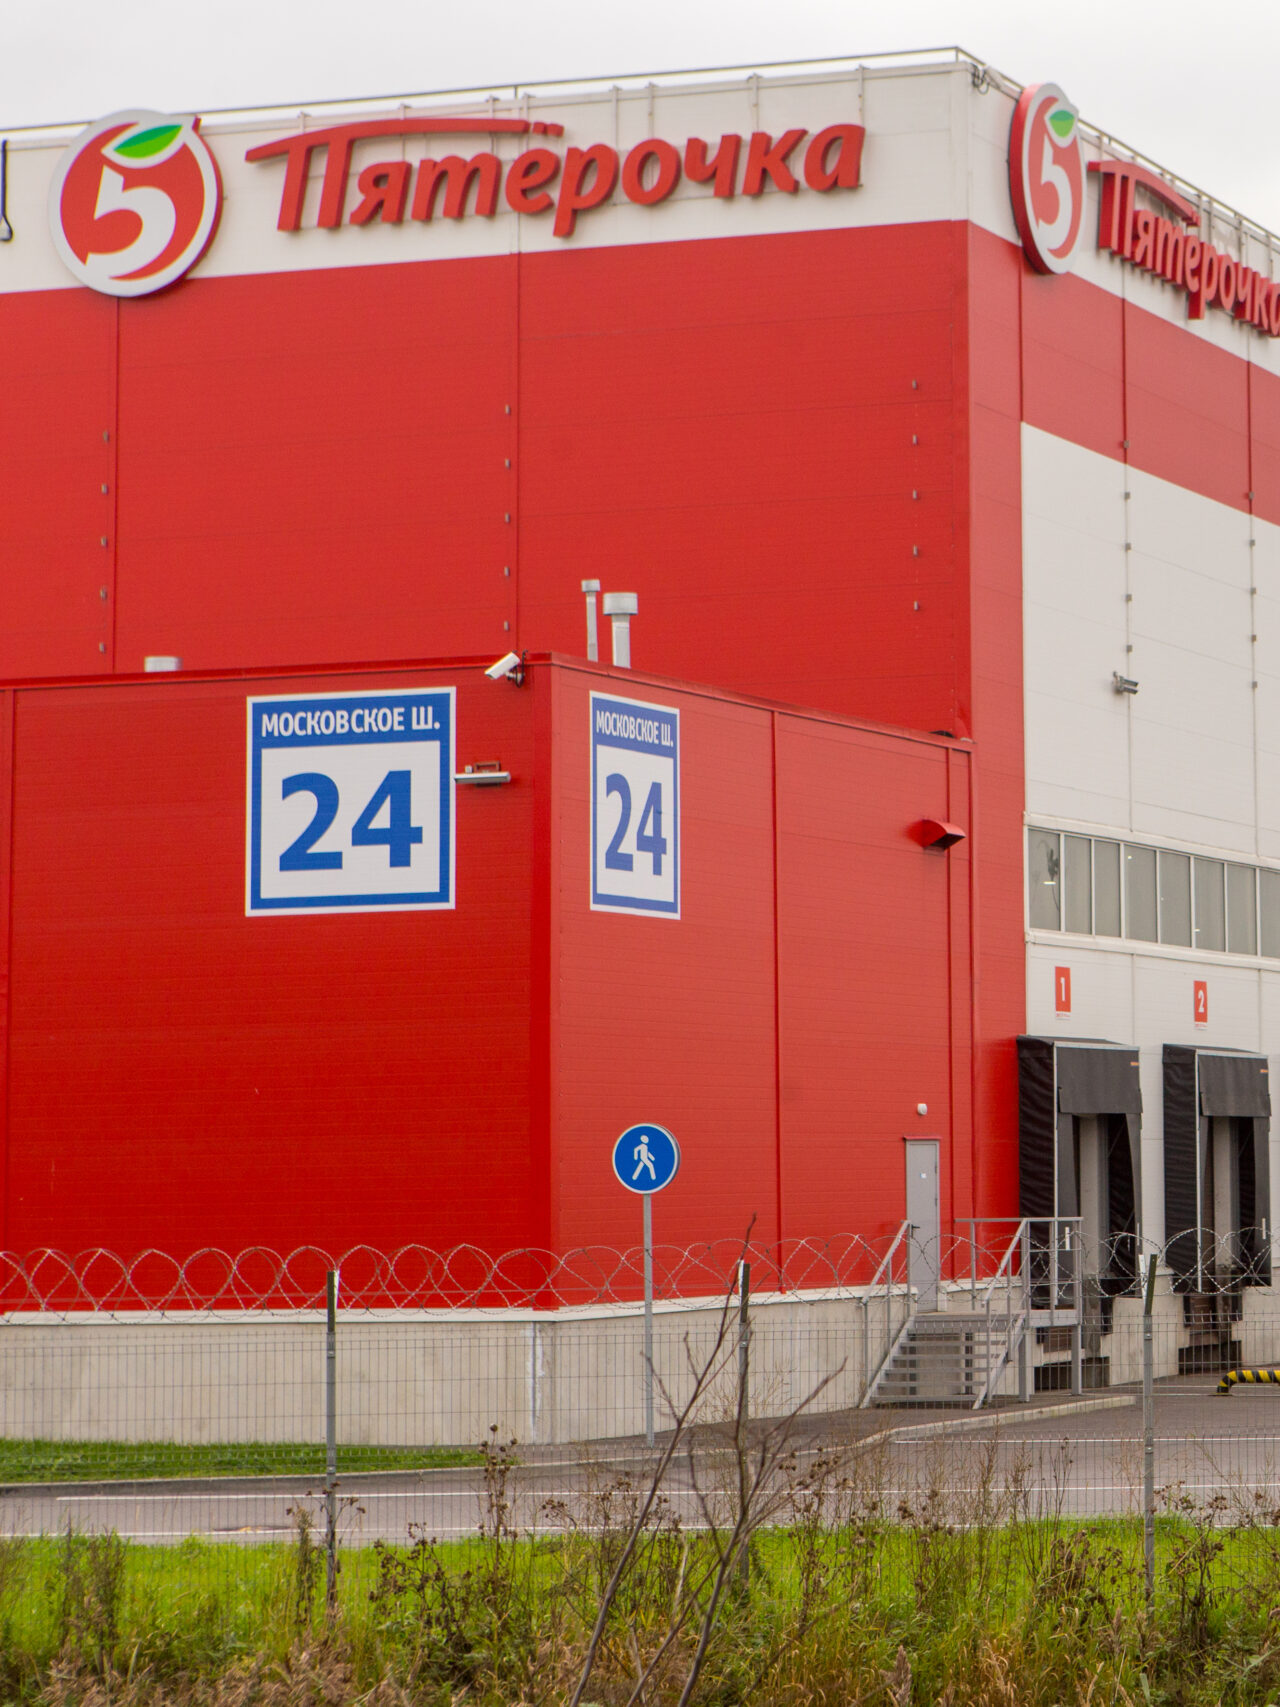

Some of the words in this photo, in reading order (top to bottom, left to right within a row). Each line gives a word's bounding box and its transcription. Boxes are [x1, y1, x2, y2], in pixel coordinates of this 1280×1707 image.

[261, 707, 404, 737] МОСКОВСКОЕ
[411, 705, 441, 731] Ш.
[596, 709, 659, 745] МОСКОВСКОЕ
[660, 720, 674, 747] Ш.
[278, 769, 424, 873] 24
[605, 772, 667, 876] 24
[1198, 989, 1205, 1013] 2
